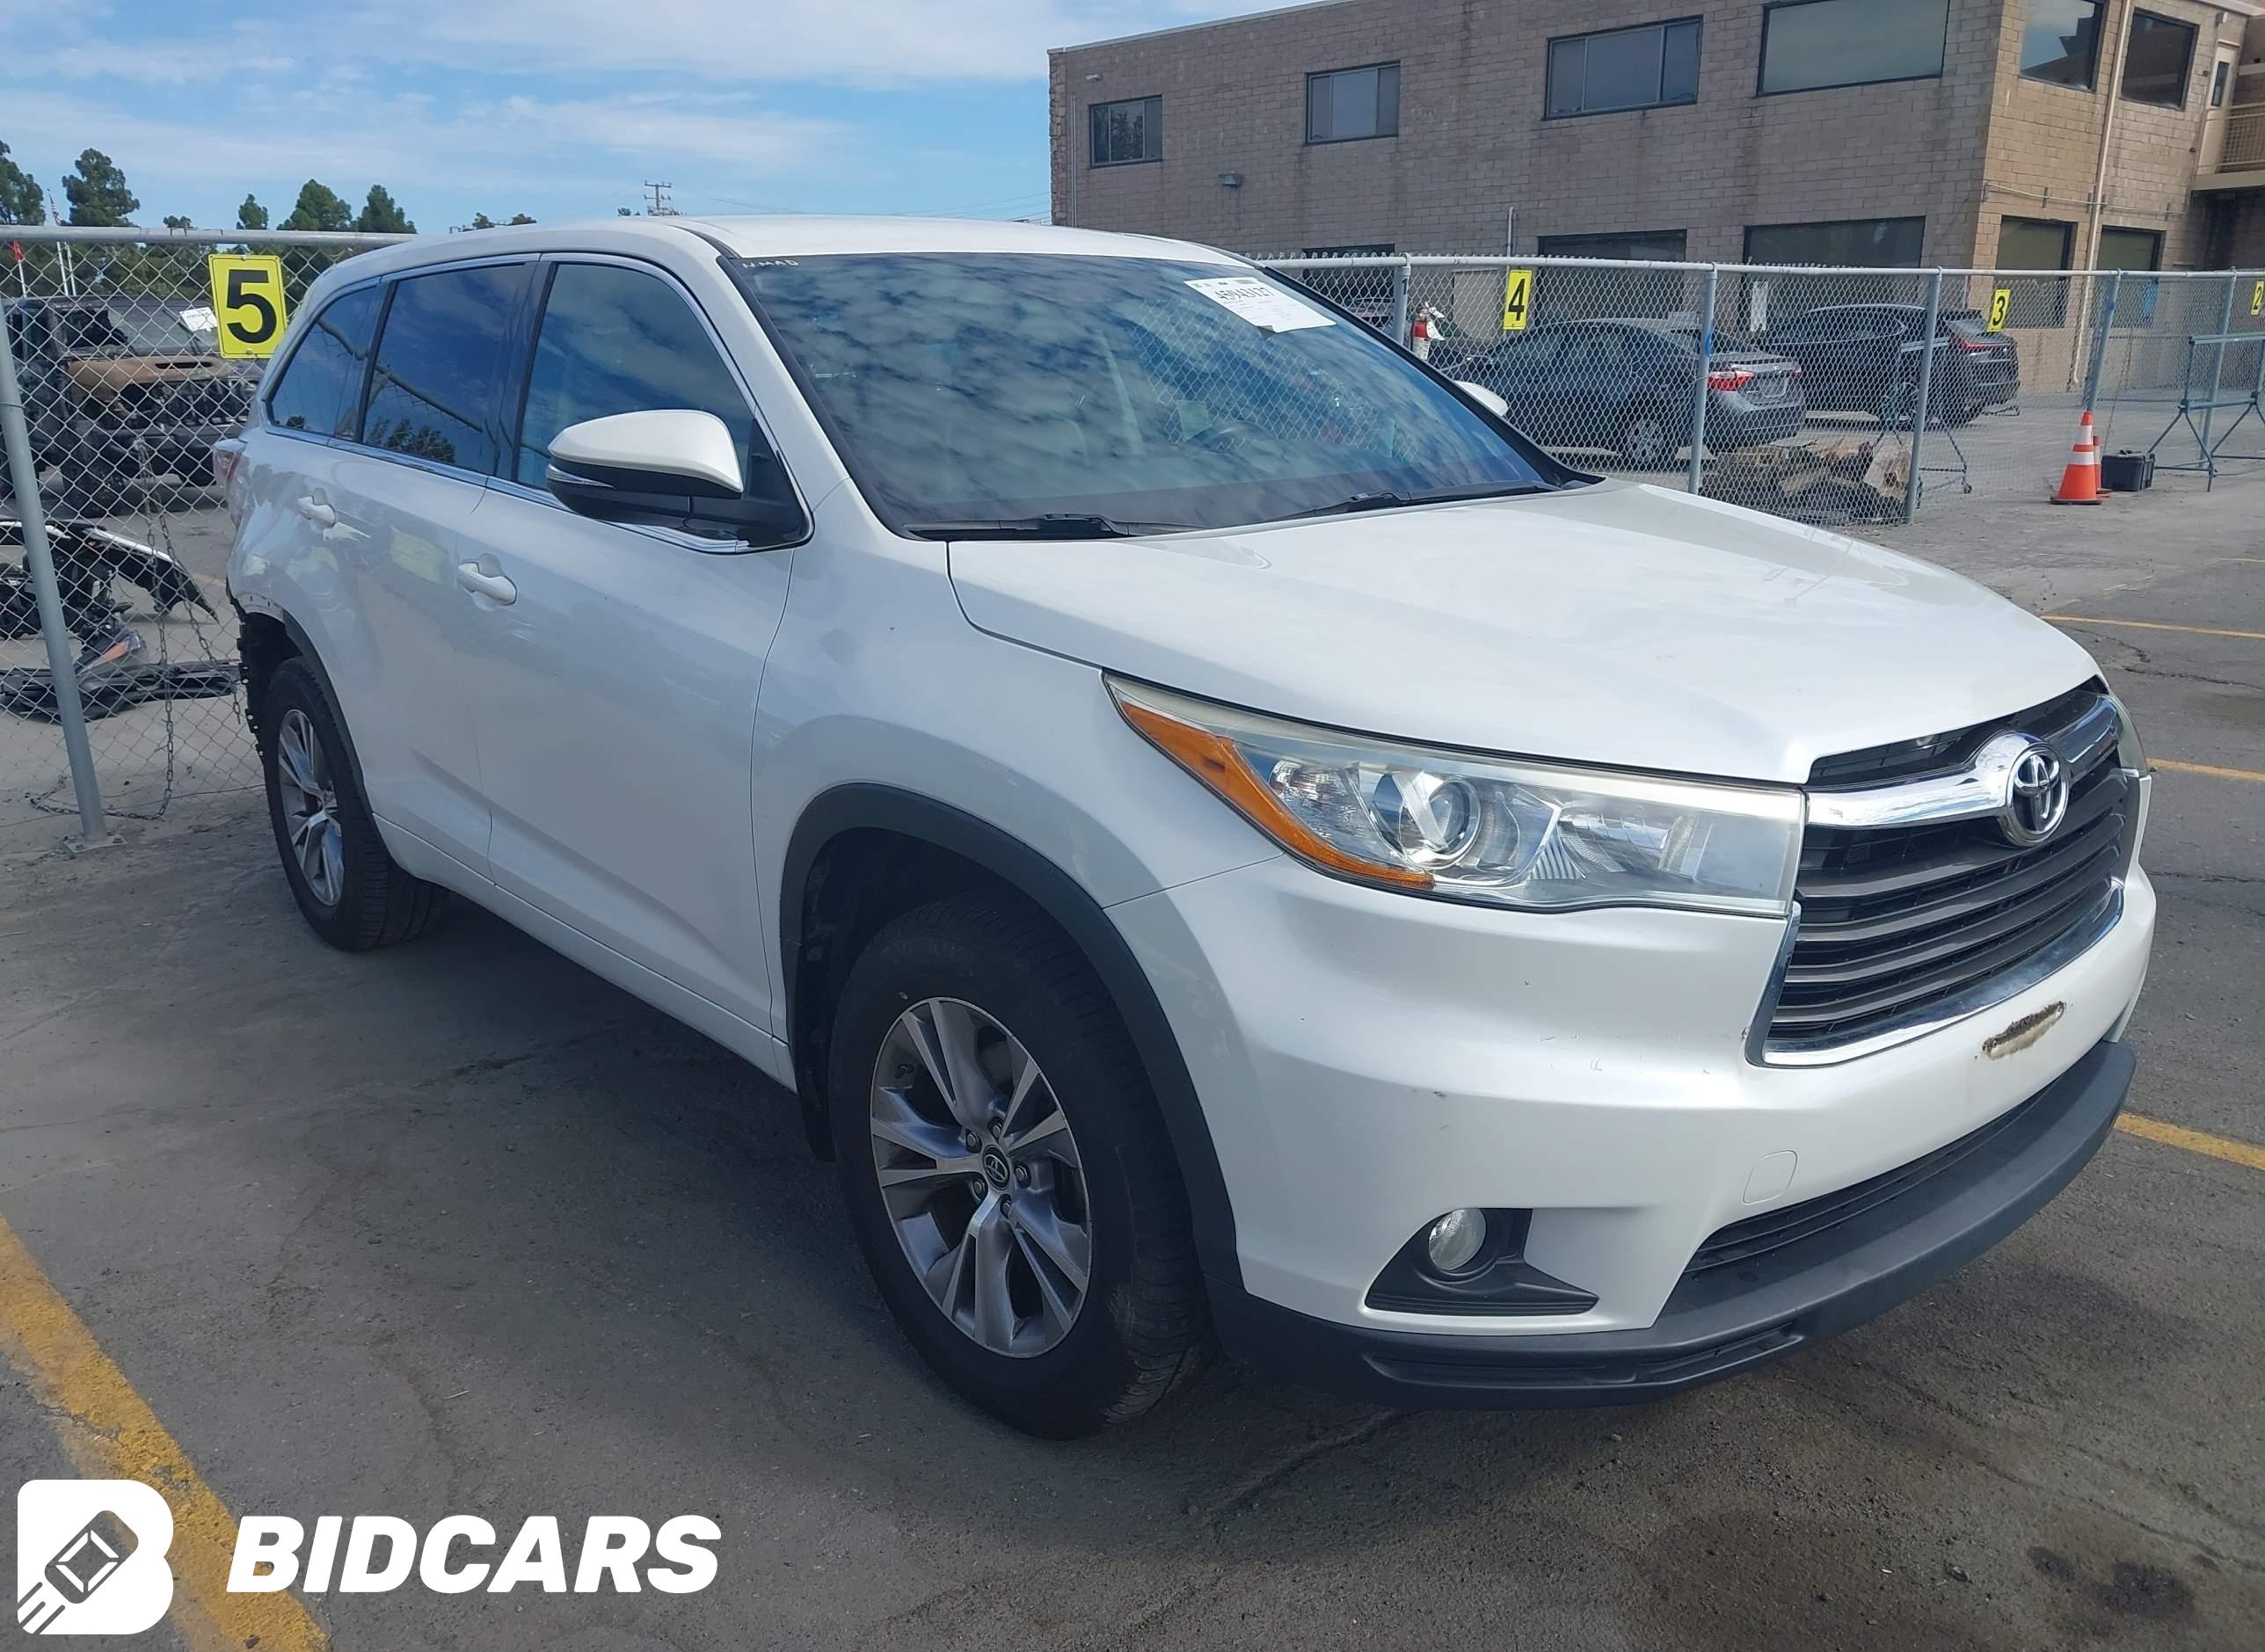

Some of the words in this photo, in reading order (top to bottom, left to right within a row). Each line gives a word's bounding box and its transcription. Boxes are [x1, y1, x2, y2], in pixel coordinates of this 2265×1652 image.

[226, 268, 278, 344] 5
[1508, 278, 1526, 322] 4
[1992, 295, 2006, 326] 3
[2253, 286, 2262, 310] 2
